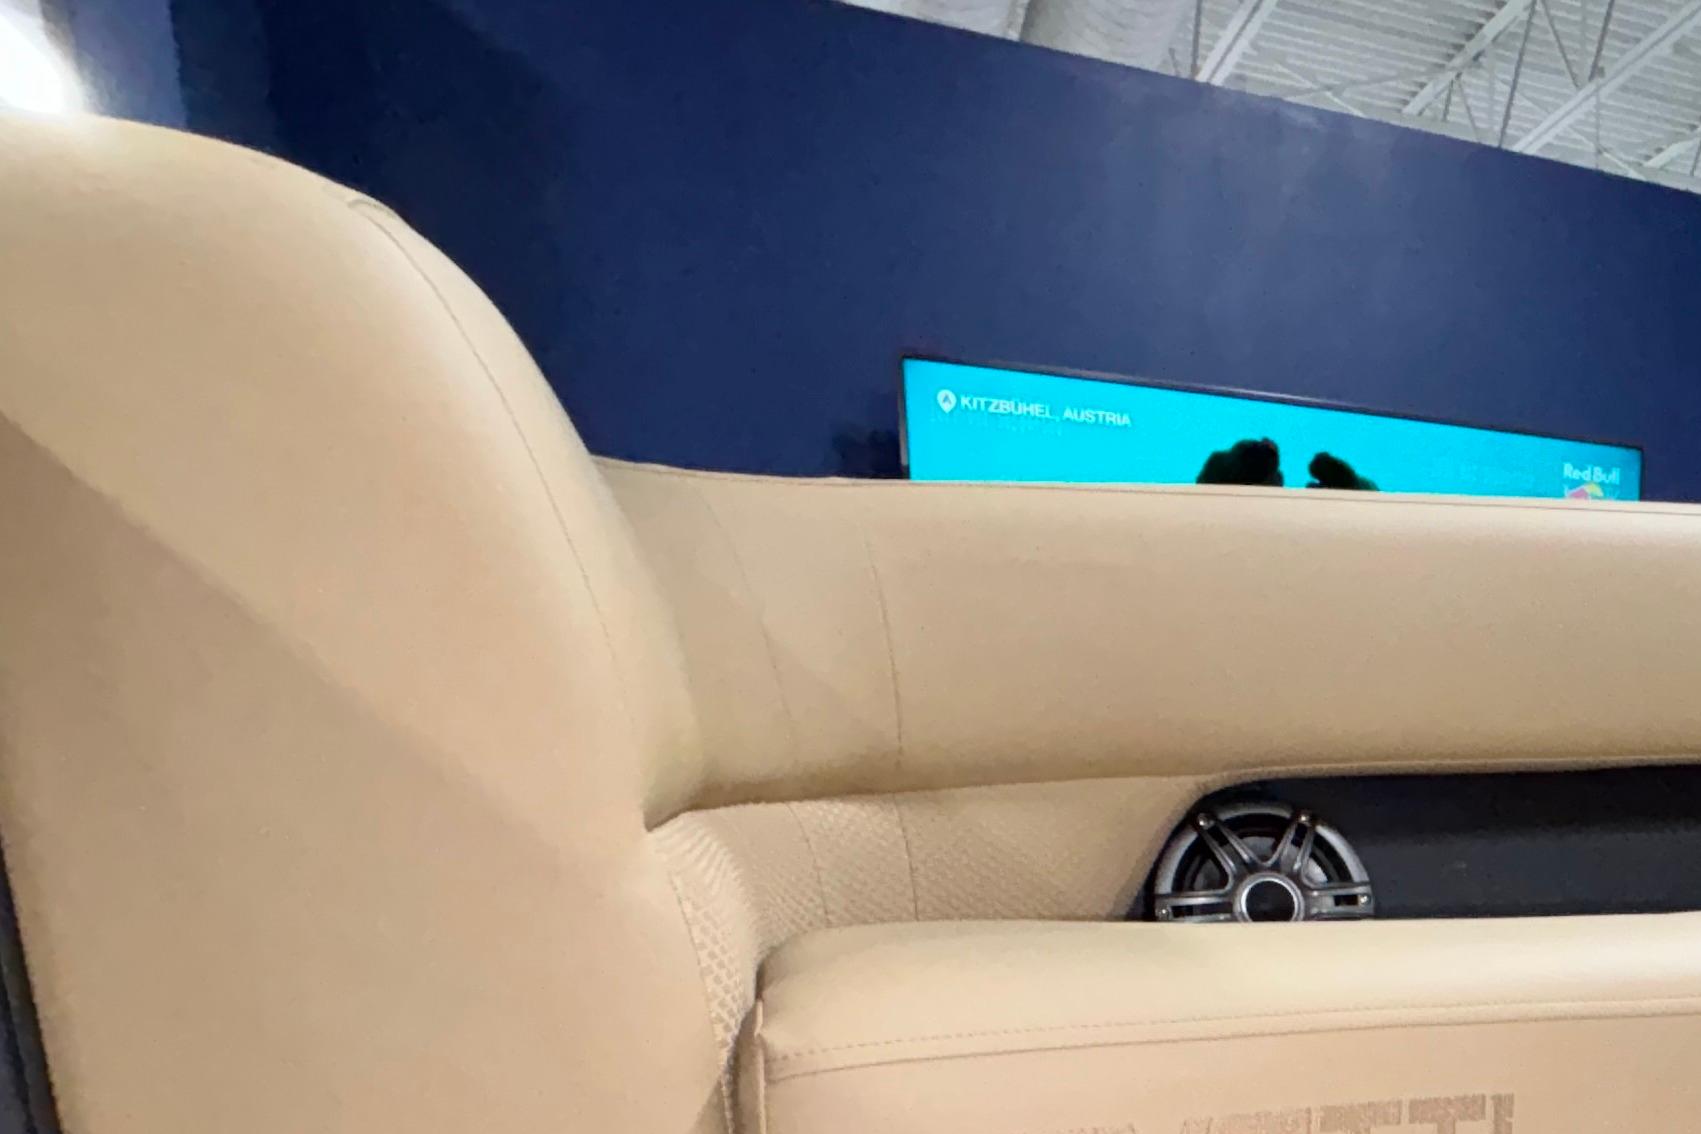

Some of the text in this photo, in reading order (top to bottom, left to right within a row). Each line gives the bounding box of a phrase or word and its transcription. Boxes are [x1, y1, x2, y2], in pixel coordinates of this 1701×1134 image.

[1062, 407, 1132, 427] AUSTRIA
[1563, 462, 1621, 485] Red Bull
